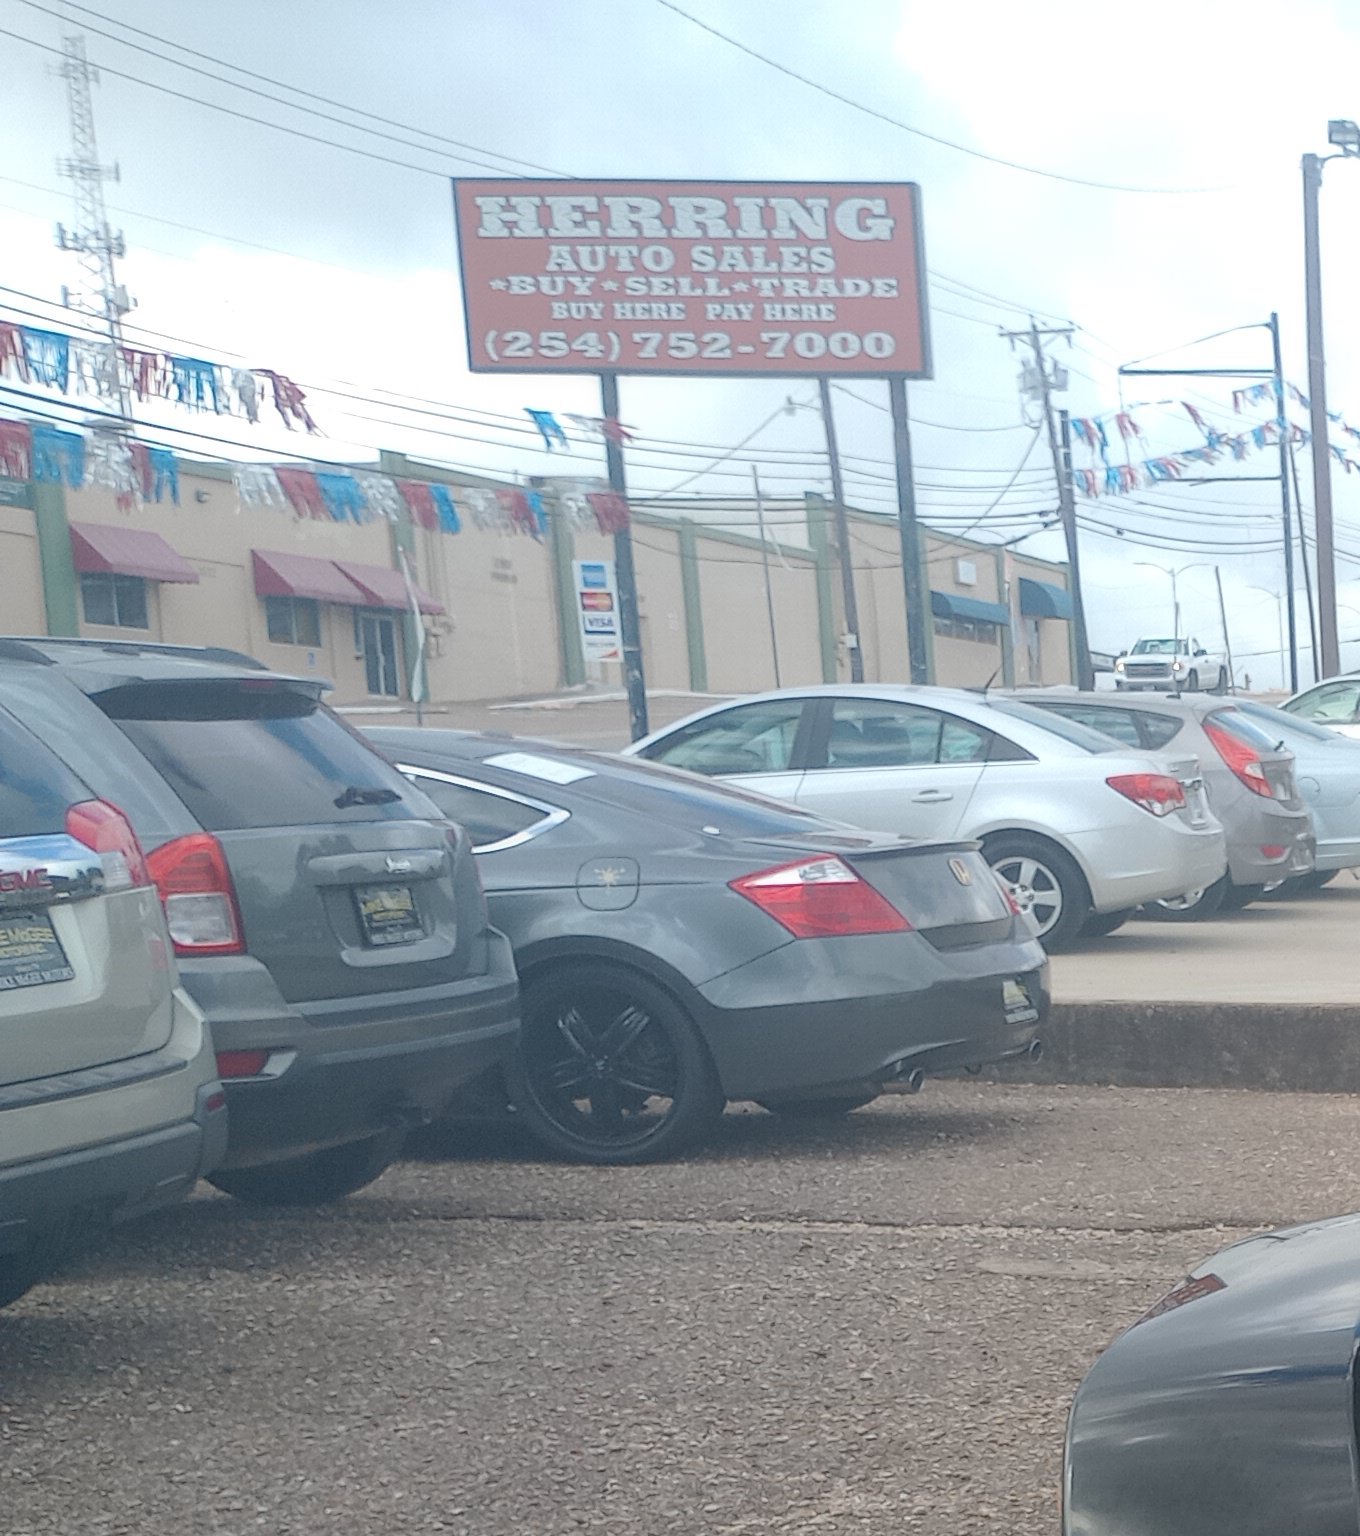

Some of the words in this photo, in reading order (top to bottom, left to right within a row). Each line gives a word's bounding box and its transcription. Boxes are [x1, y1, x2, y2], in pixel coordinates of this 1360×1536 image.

[475, 196, 896, 241] HERRING
[545, 244, 675, 273] AUTO
[691, 244, 837, 274] SALES
[507, 275, 596, 296] BUY
[624, 276, 732, 297] SELL
[752, 277, 898, 298] TRADE
[550, 301, 604, 320] BUY
[612, 302, 687, 321] HERE
[705, 302, 754, 321] PAY
[762, 303, 837, 321] HERE
[484, 329, 622, 362] (254)
[631, 331, 896, 359] 752-7000
